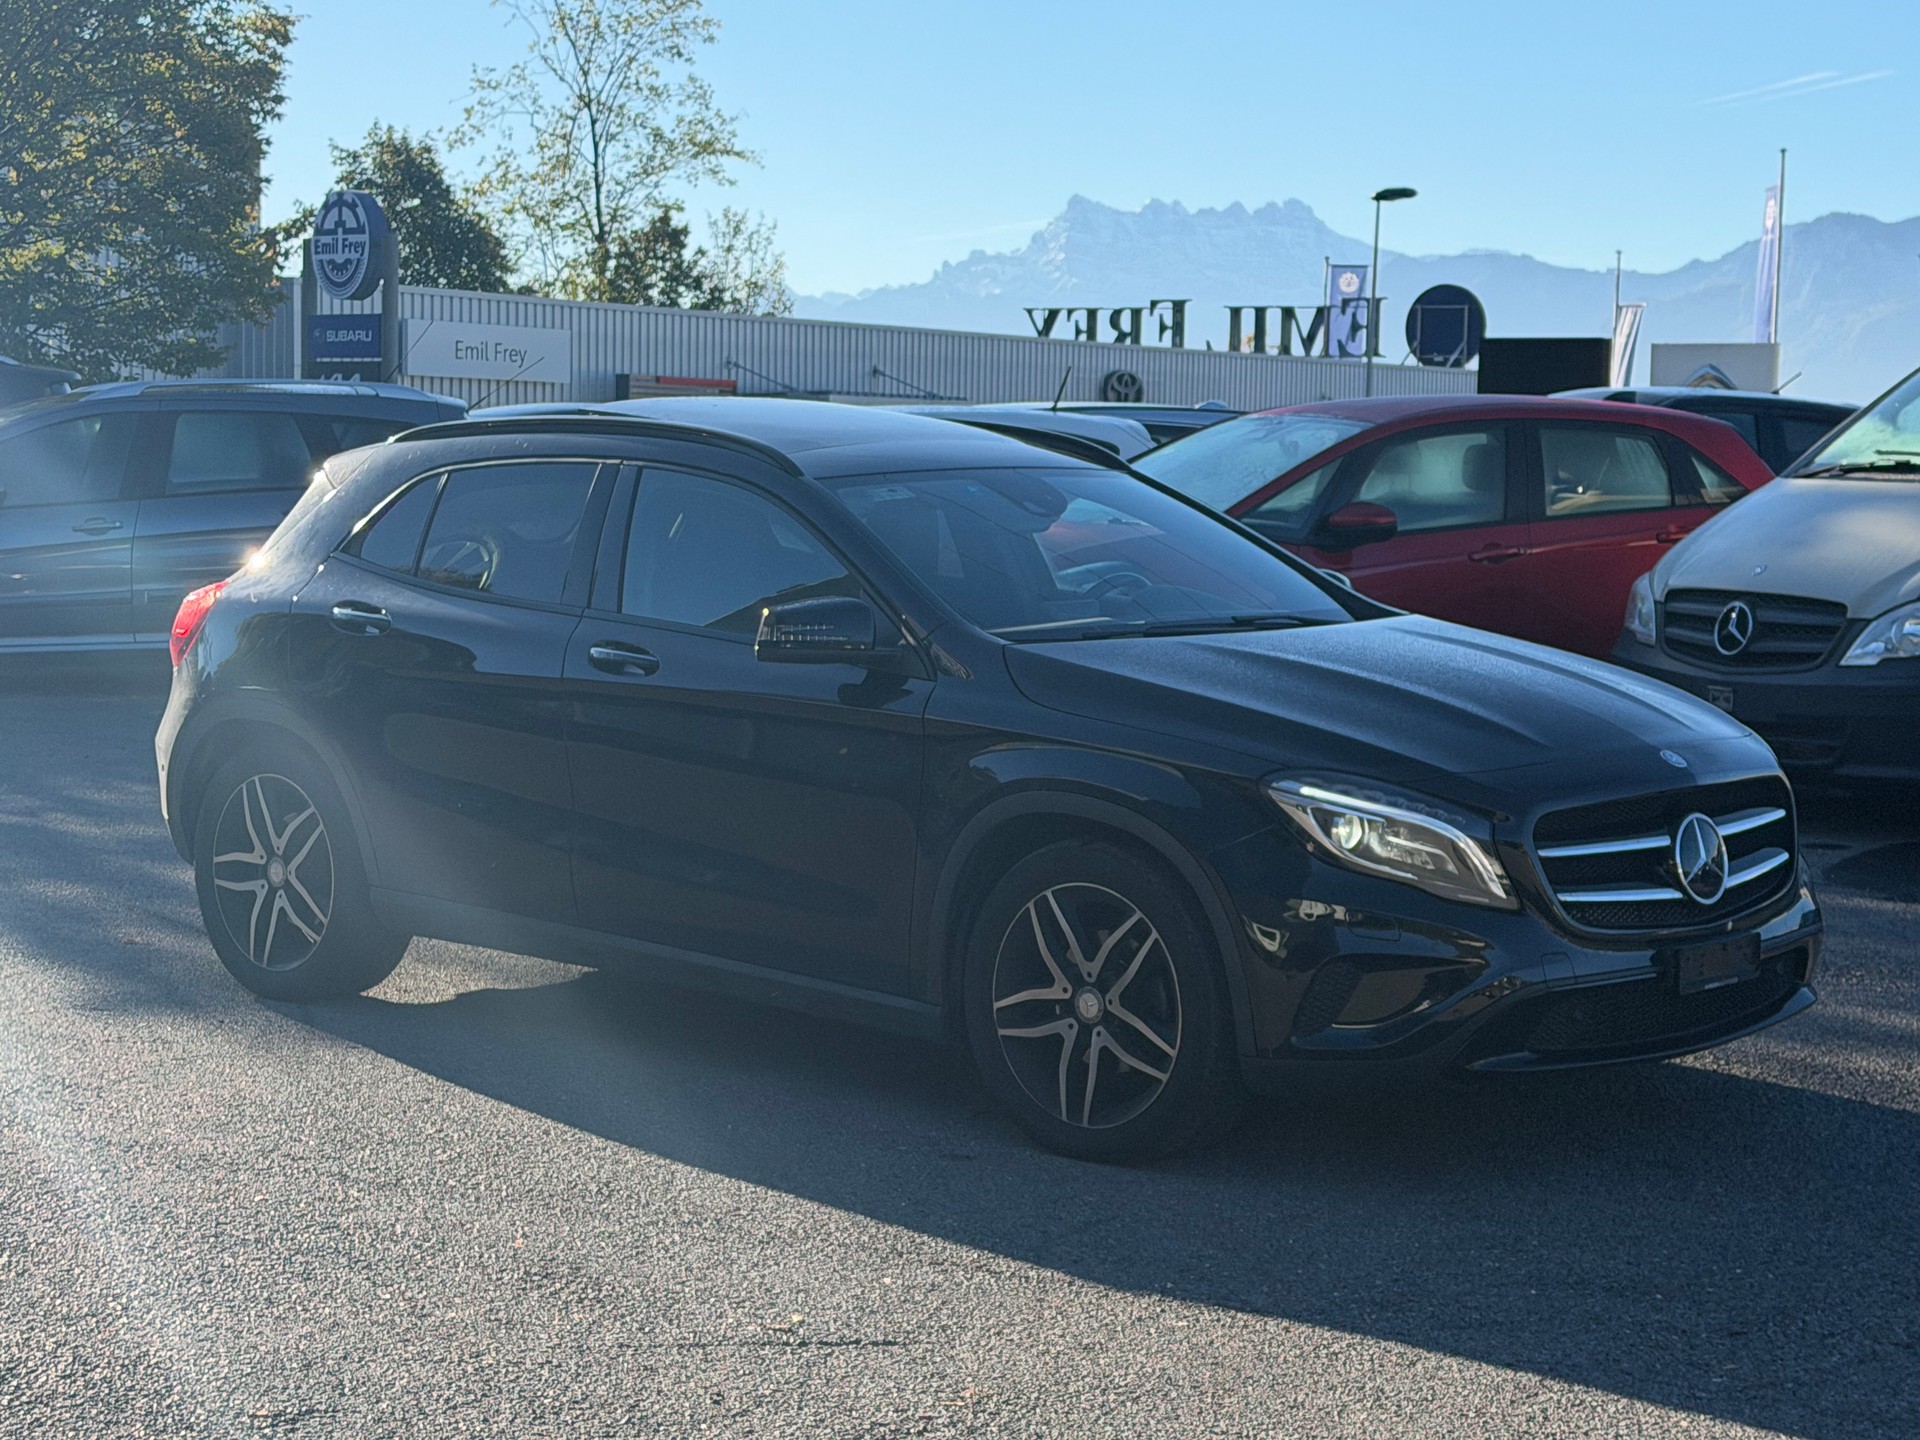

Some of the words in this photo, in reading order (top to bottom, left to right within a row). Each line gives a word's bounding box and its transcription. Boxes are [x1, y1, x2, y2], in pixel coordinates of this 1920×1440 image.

[314, 237, 339, 255] Emil
[341, 237, 367, 257] Frey
[326, 329, 372, 342] SUBARU
[455, 339, 490, 362] Emil
[494, 342, 528, 369] Frey
